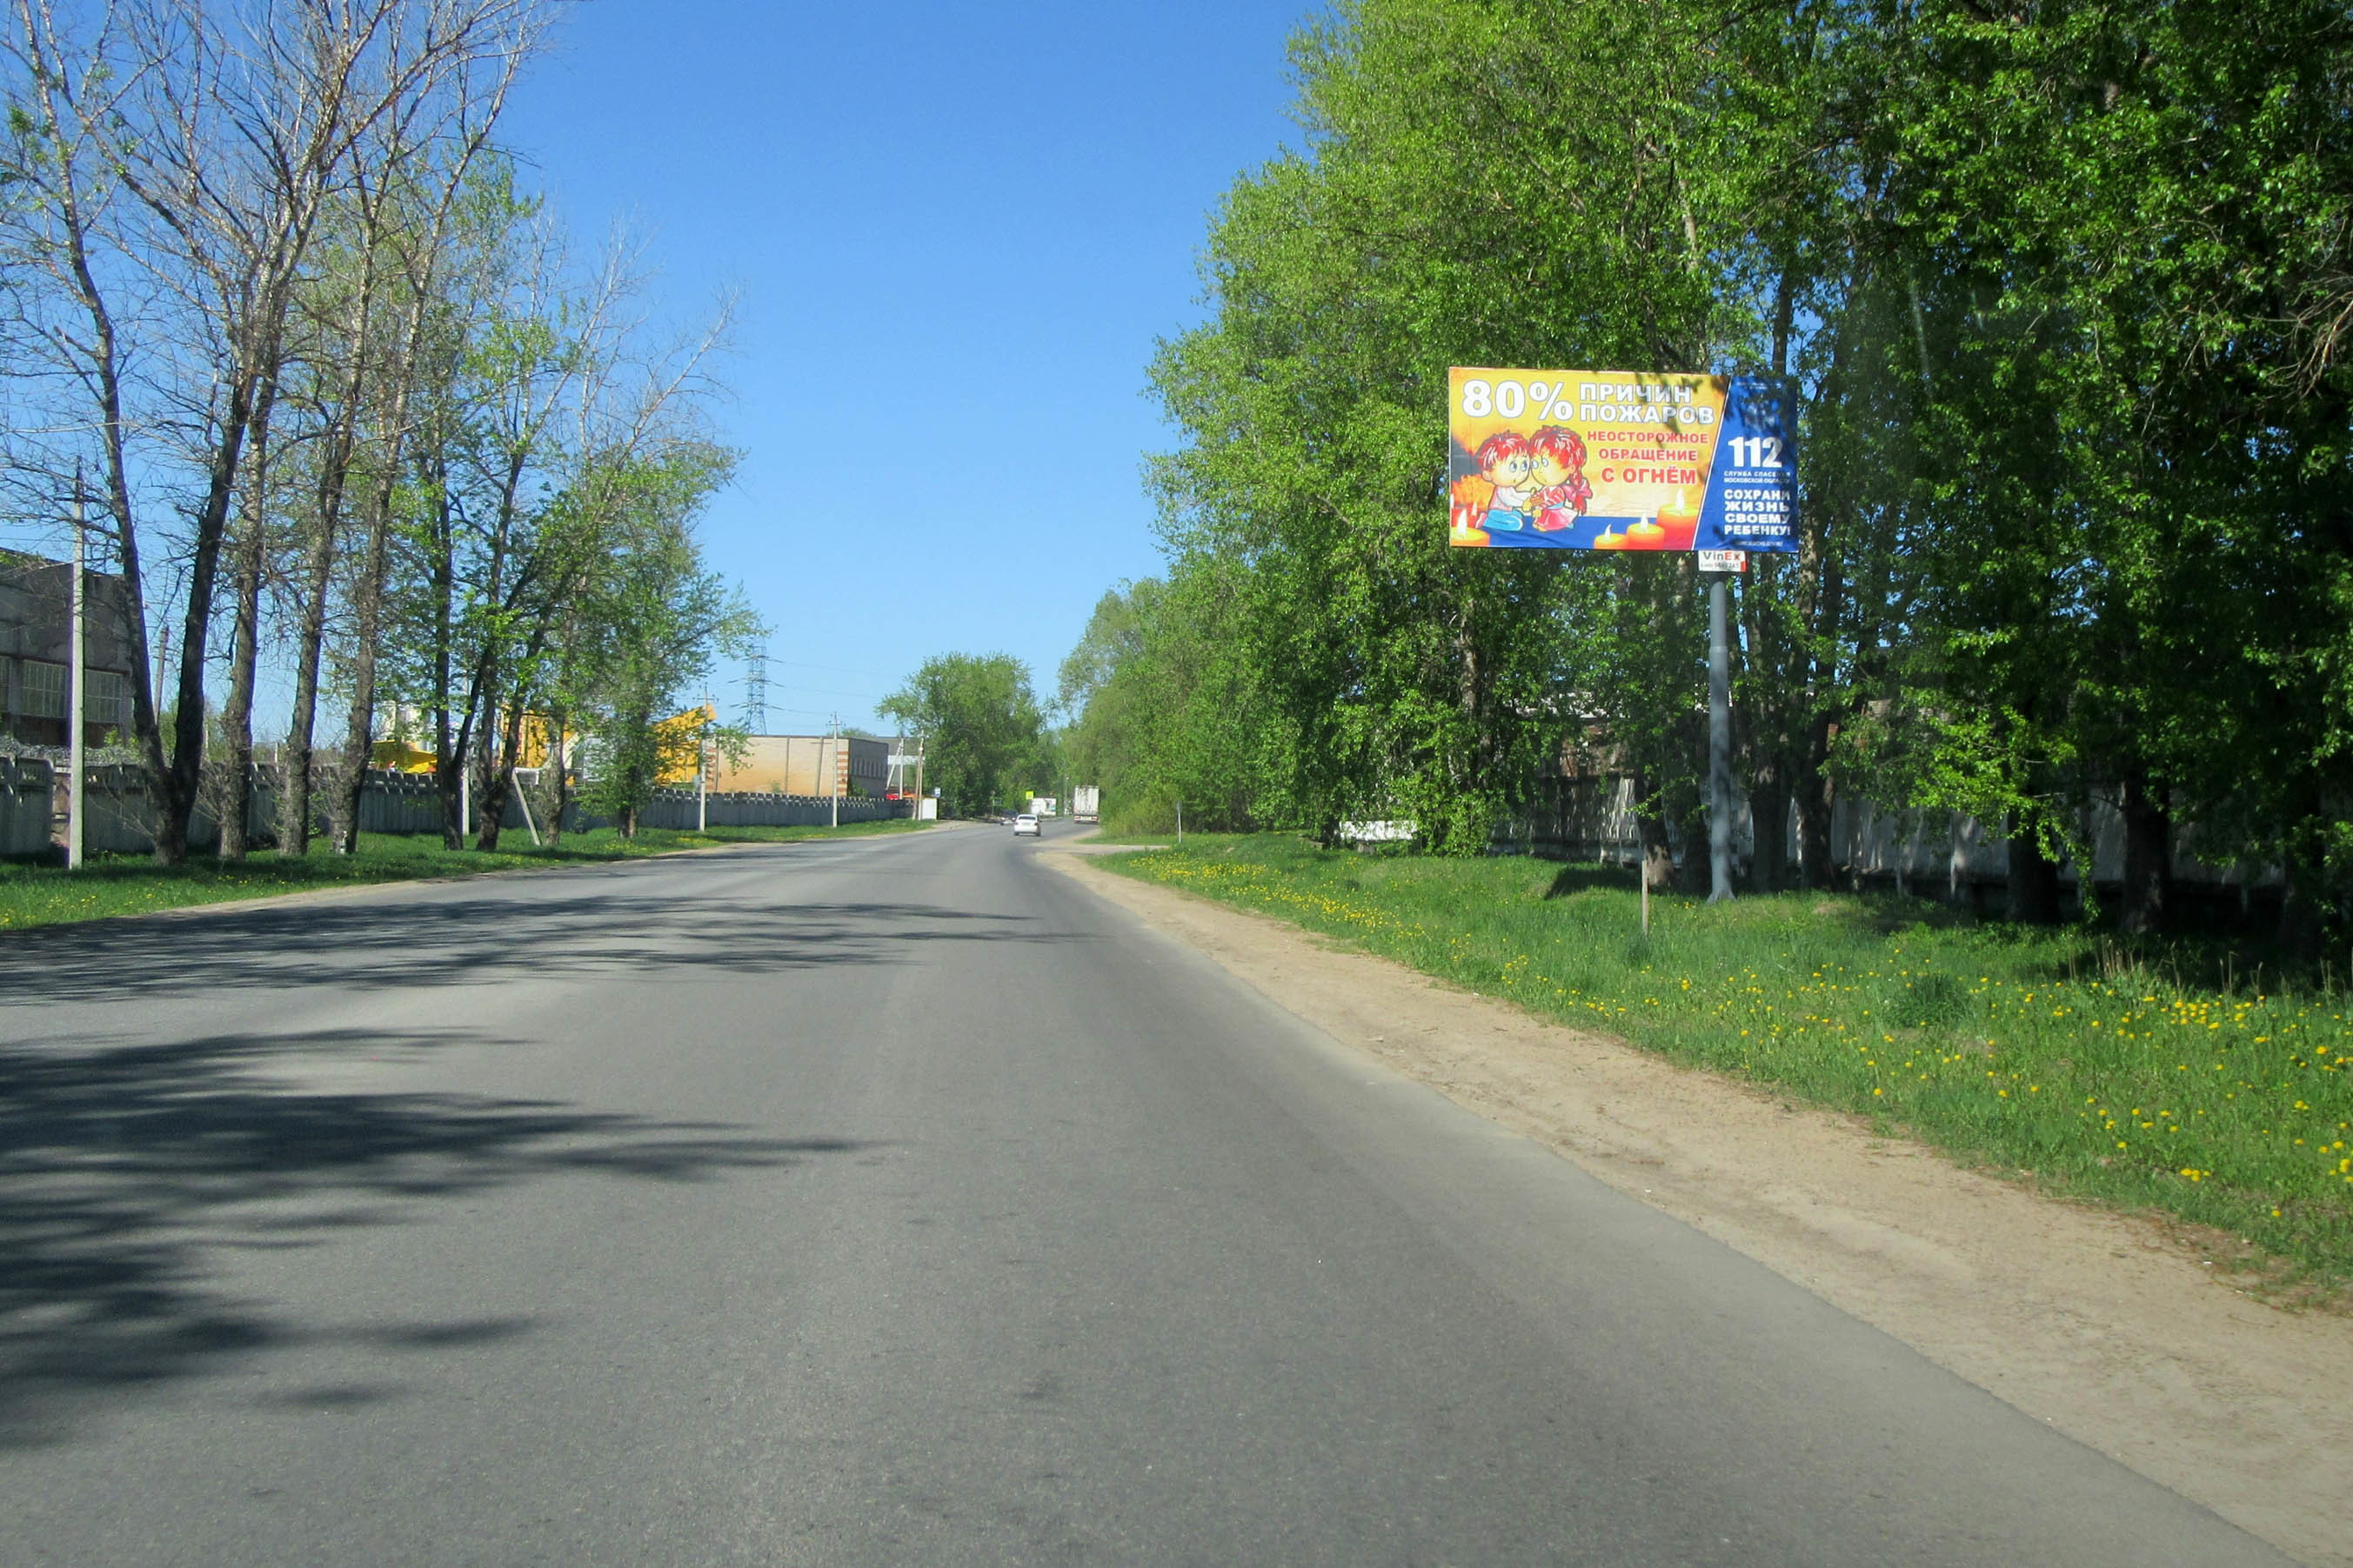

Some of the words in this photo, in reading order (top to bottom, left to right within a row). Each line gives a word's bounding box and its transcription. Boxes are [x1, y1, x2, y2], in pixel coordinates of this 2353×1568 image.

[1462, 379, 1574, 421] 80%
[1580, 383, 1691, 404] ПРИЧИН
[1580, 404, 1715, 424] ПОЖАРОВ
[1588, 431, 1708, 444] НЕОСТОРОЖНОЕ
[1599, 448, 1697, 462] ОБРАЩЕНИЕ
[1728, 437, 1782, 468] 112
[1601, 468, 1614, 483] С
[1622, 466, 1695, 484] ОГНЁМ
[1724, 489, 1790, 500] СОХРАНИ
[1724, 501, 1789, 512] ЖИЗНЬ
[1724, 513, 1790, 524] СВОЕМУ
[1724, 524, 1790, 536] РЕБЕНКУ!
